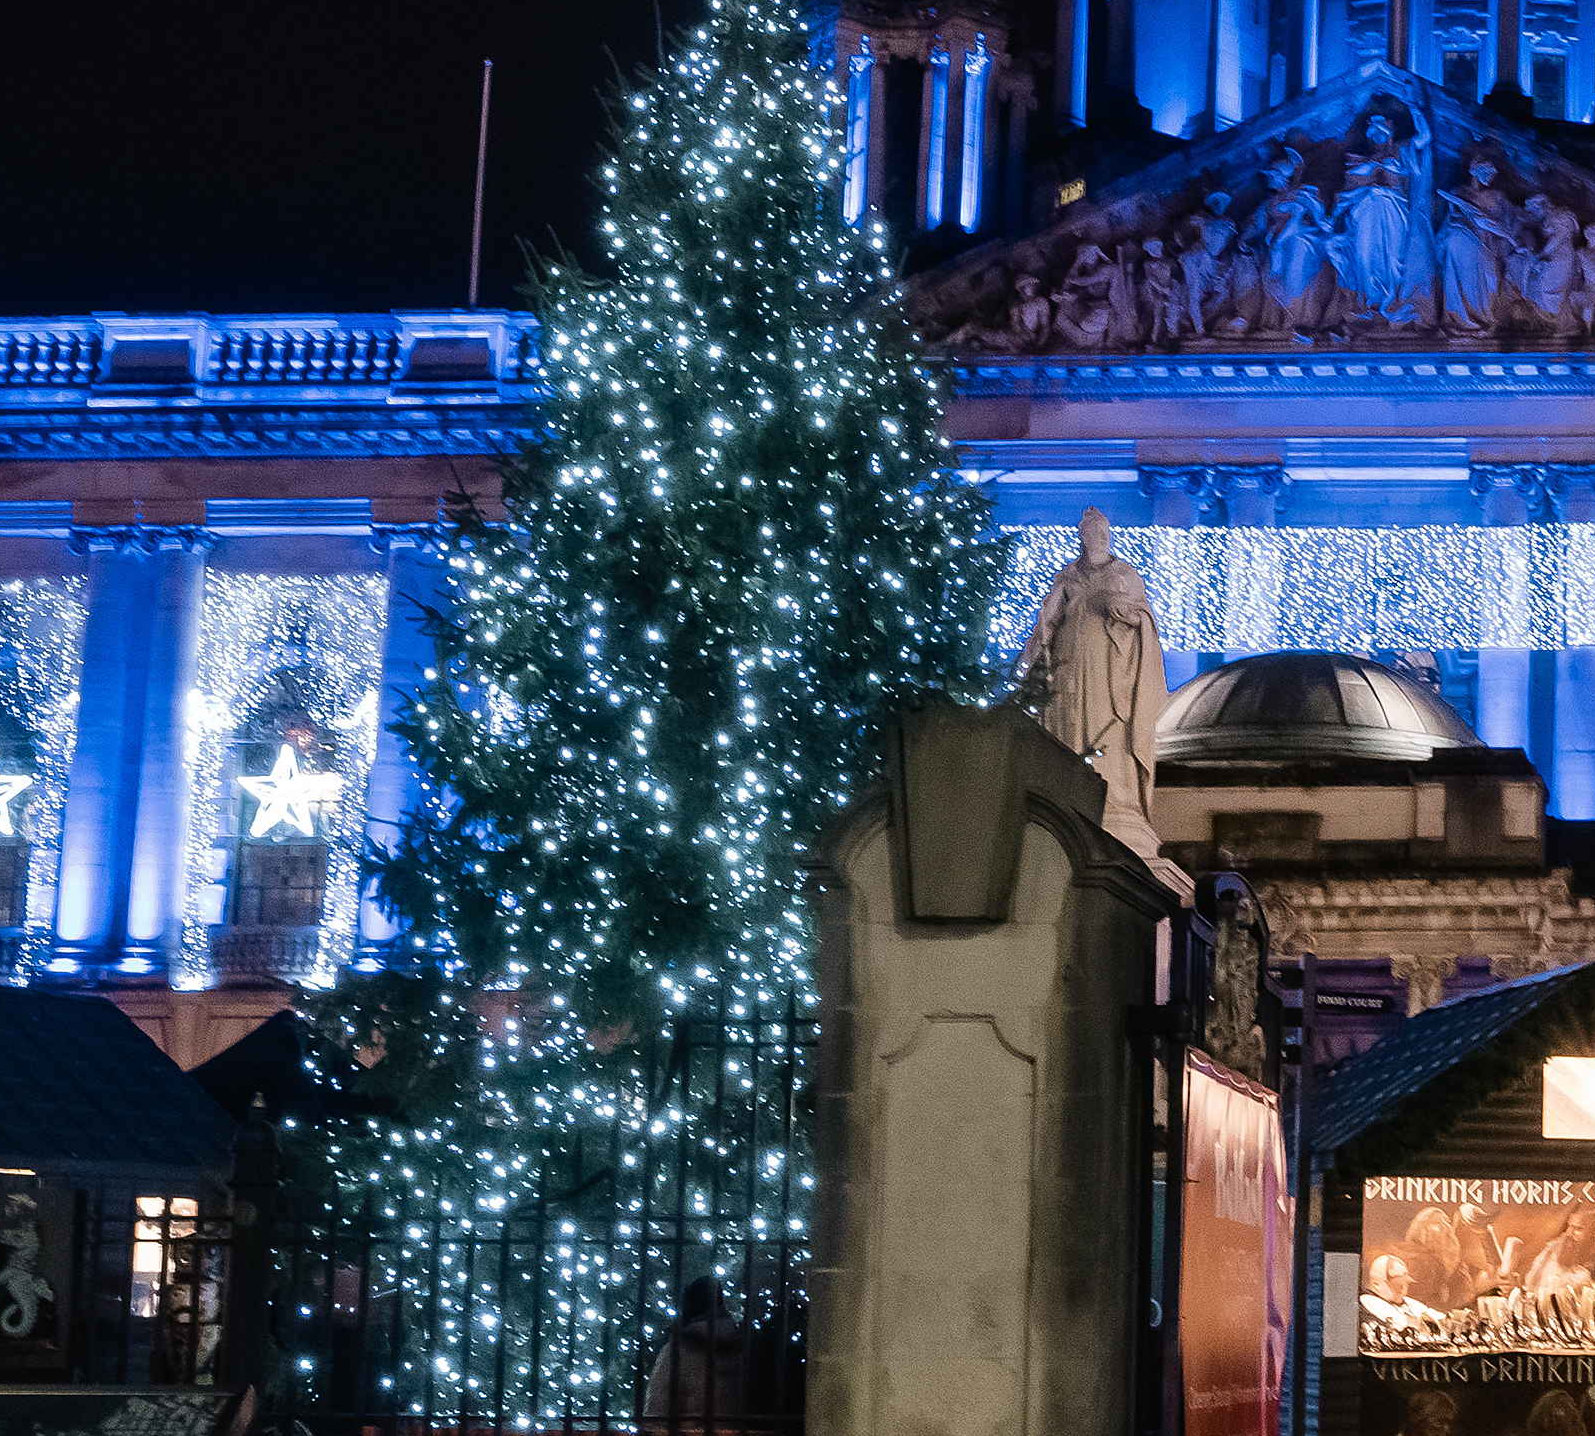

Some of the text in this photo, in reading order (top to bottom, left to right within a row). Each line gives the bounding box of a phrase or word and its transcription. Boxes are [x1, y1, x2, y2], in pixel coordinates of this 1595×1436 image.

[1316, 994, 1384, 1009] FOOD COURT
[1364, 1176, 1484, 1204] DRINKING
[1371, 1358, 1470, 1383] VIKING
